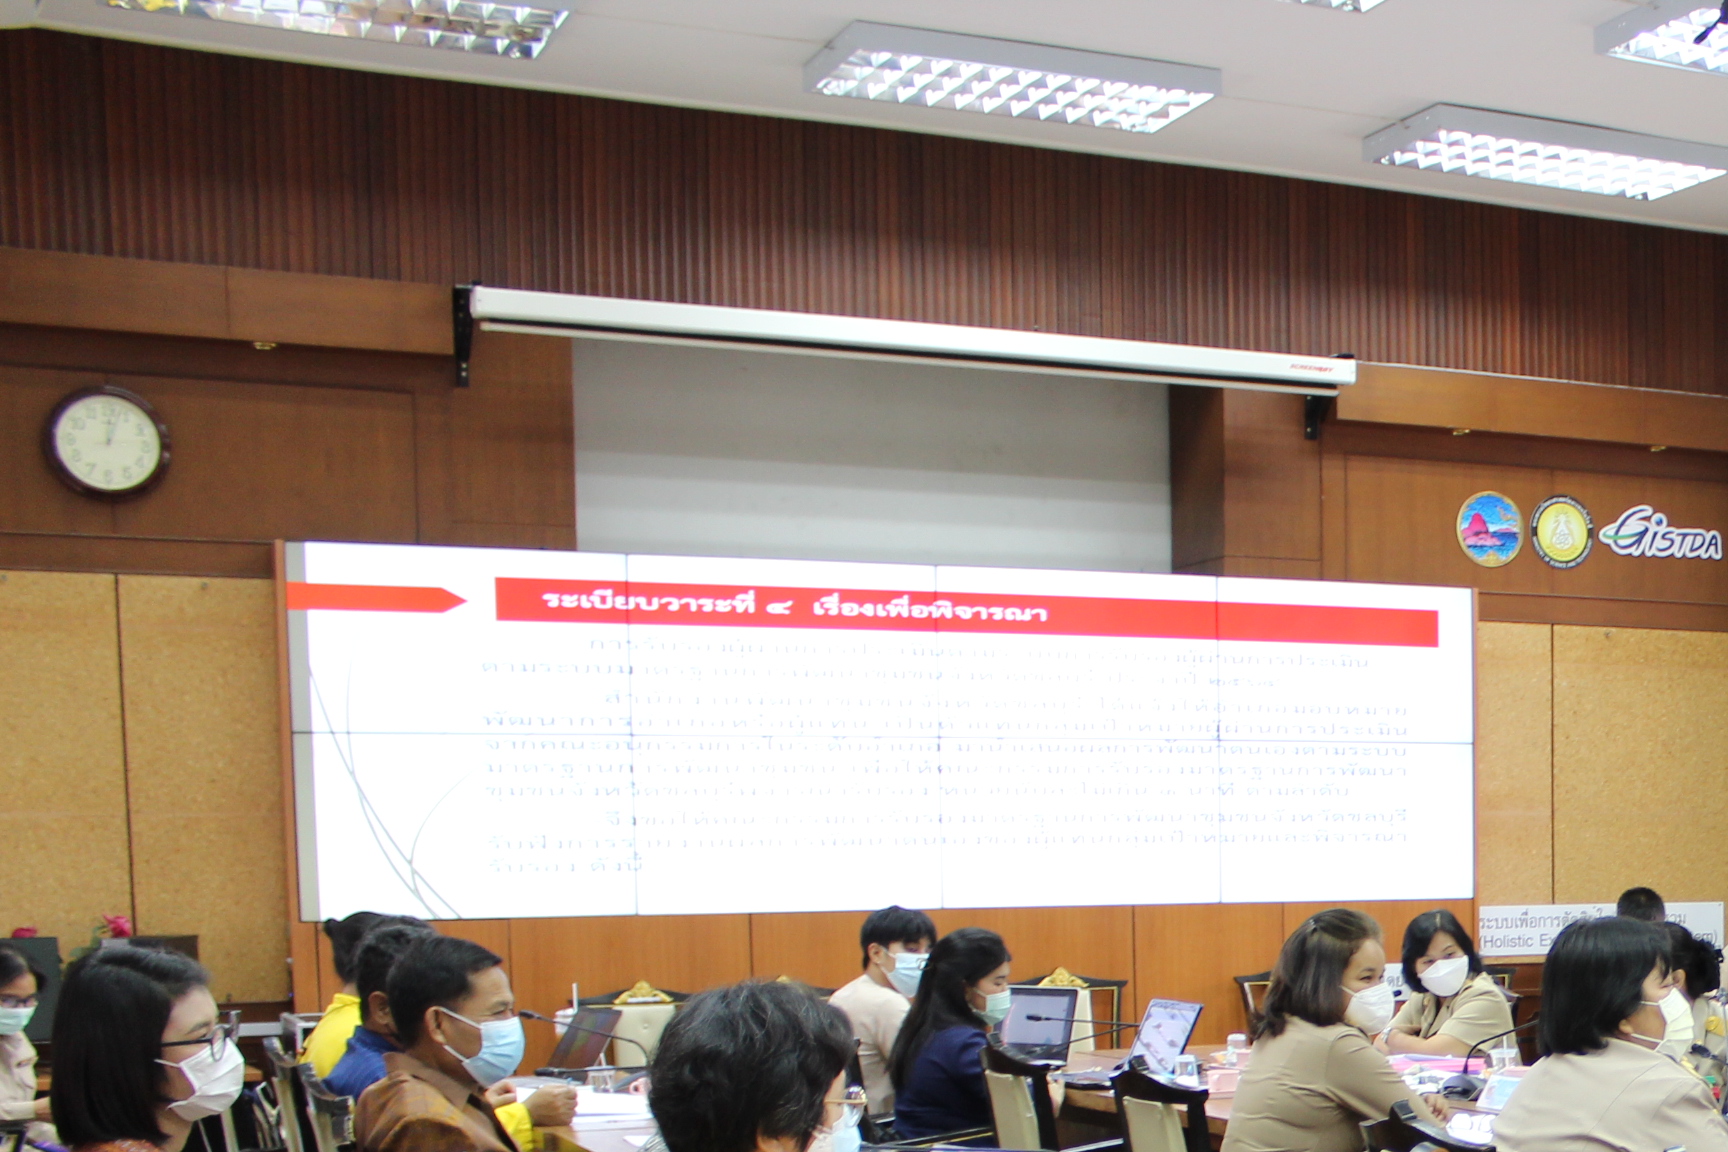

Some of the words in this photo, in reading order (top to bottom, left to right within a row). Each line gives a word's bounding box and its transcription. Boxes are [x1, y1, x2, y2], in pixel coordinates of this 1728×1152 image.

[542, 589, 757, 613] ระเบียบวาระที่
[813, 595, 1048, 621] เรื่องเพื่อพิจารณา
[1480, 932, 1535, 950] (Holistic
